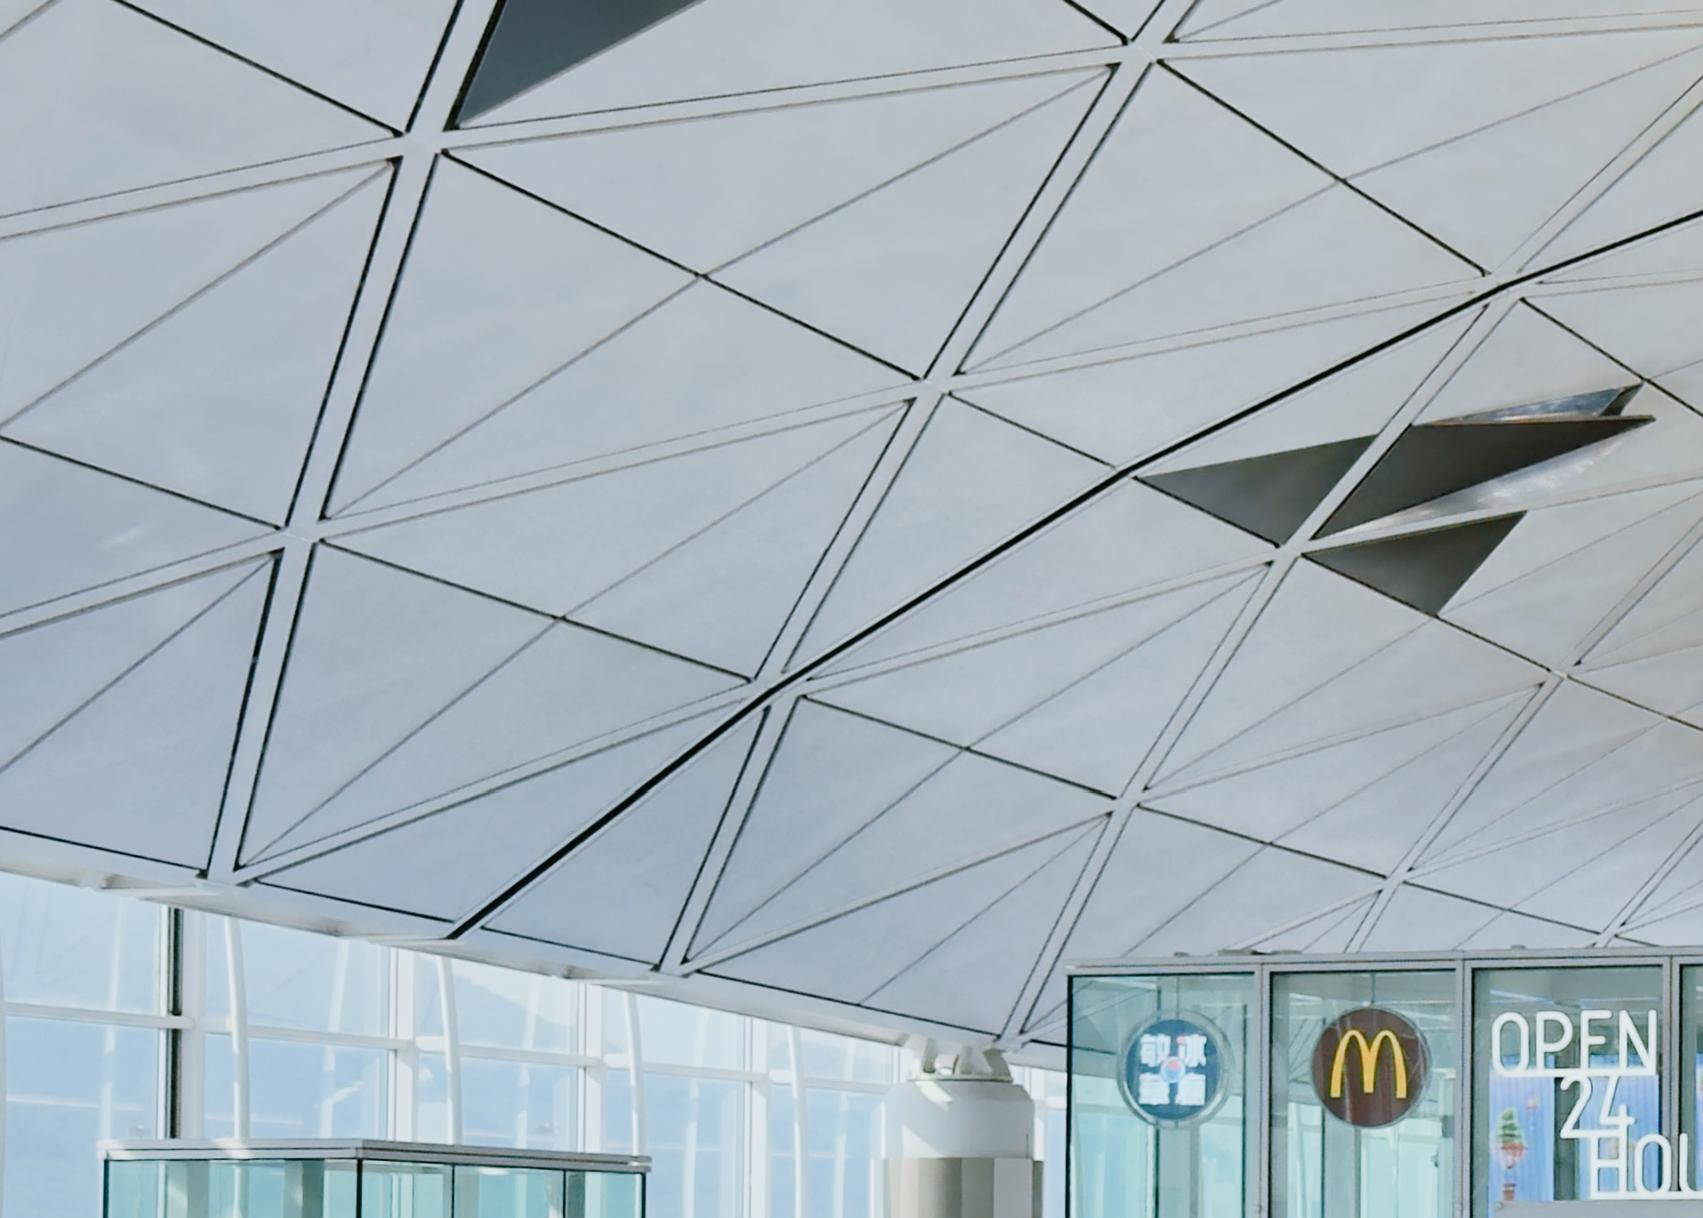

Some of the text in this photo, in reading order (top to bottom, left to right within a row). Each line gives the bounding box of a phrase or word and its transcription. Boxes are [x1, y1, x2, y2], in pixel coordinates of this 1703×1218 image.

[1330, 1029, 1407, 1098] M
[1491, 1009, 1658, 1077] OPEN
[1560, 1075, 1636, 1139] 24
